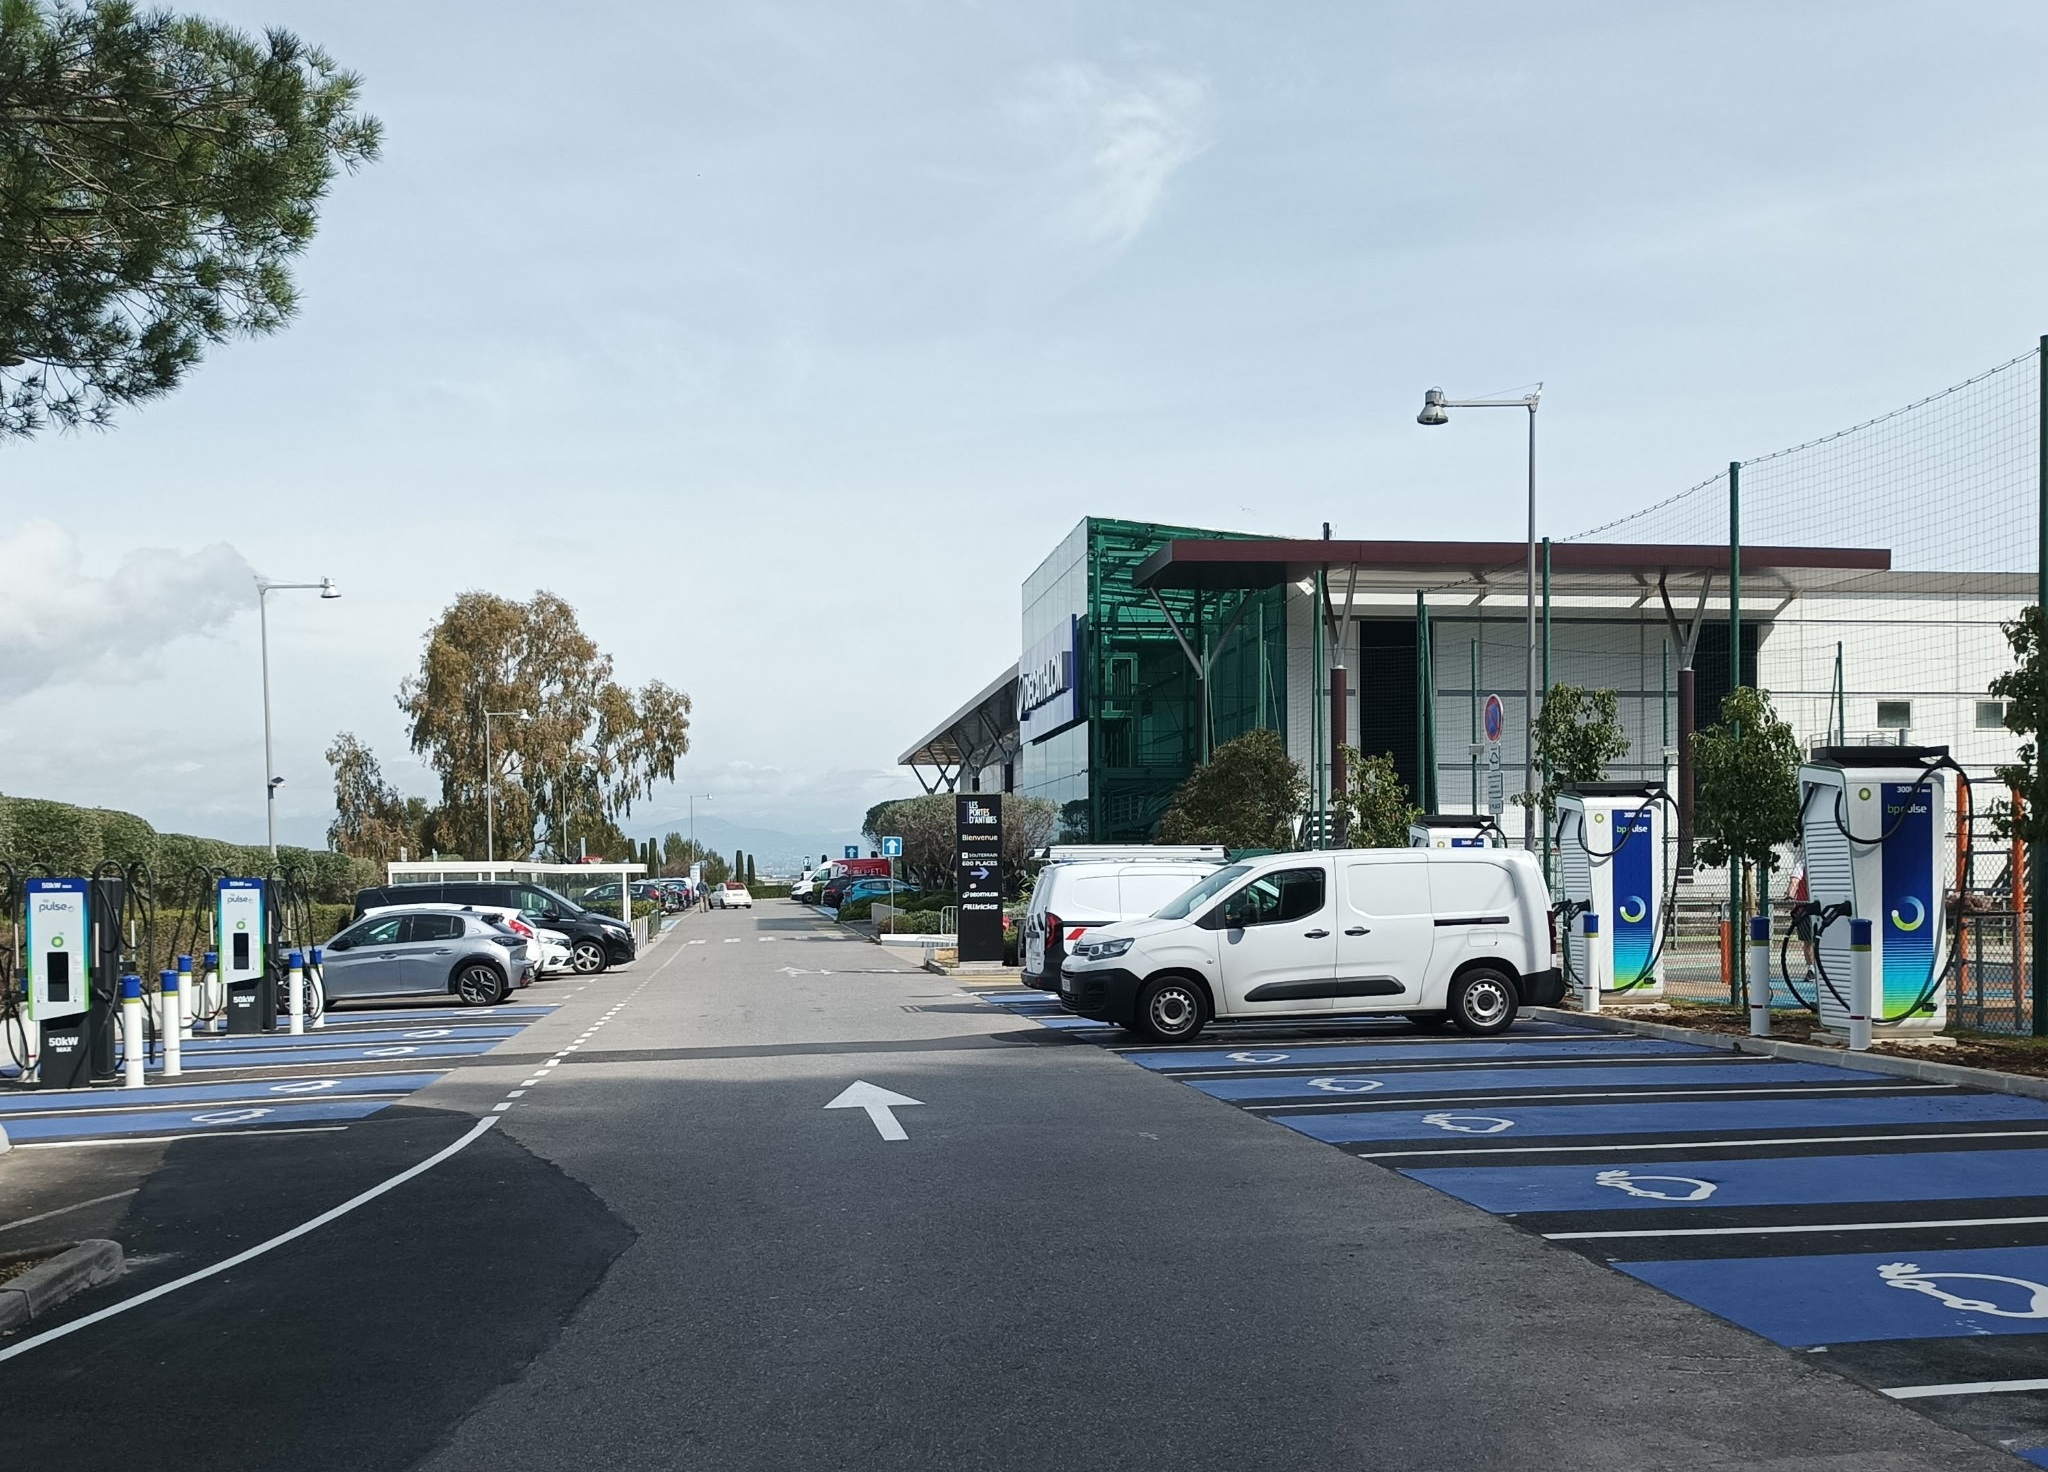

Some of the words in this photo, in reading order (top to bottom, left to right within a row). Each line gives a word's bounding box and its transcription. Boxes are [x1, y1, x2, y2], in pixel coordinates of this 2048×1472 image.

[1024, 651, 1063, 711] DECATHLON
[969, 808, 990, 816] PORTES
[227, 895, 248, 904] pulse
[39, 901, 67, 913] pulse
[233, 995, 256, 1003] 50kW
[48, 1036, 79, 1047] 50kW
